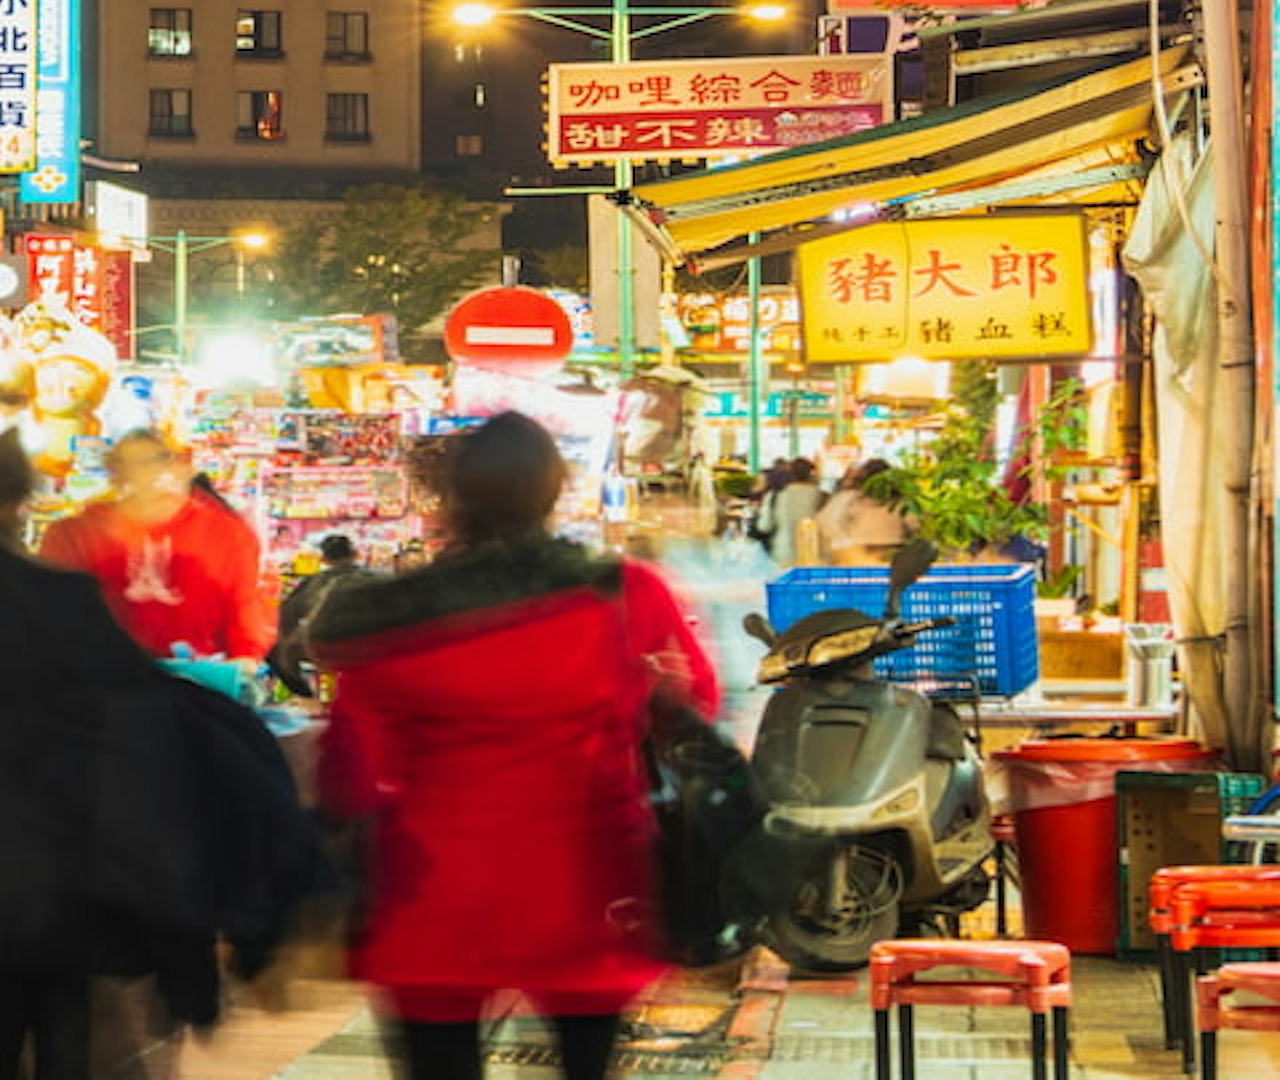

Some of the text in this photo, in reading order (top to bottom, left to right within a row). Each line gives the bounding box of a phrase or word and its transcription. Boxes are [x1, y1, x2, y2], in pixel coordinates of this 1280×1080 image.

[568, 70, 866, 107] 咖哩綜合麵
[565, 116, 771, 150] 甜不辣
[829, 244, 1058, 305] 豬大郎
[919, 312, 1073, 344] 豬血糕
